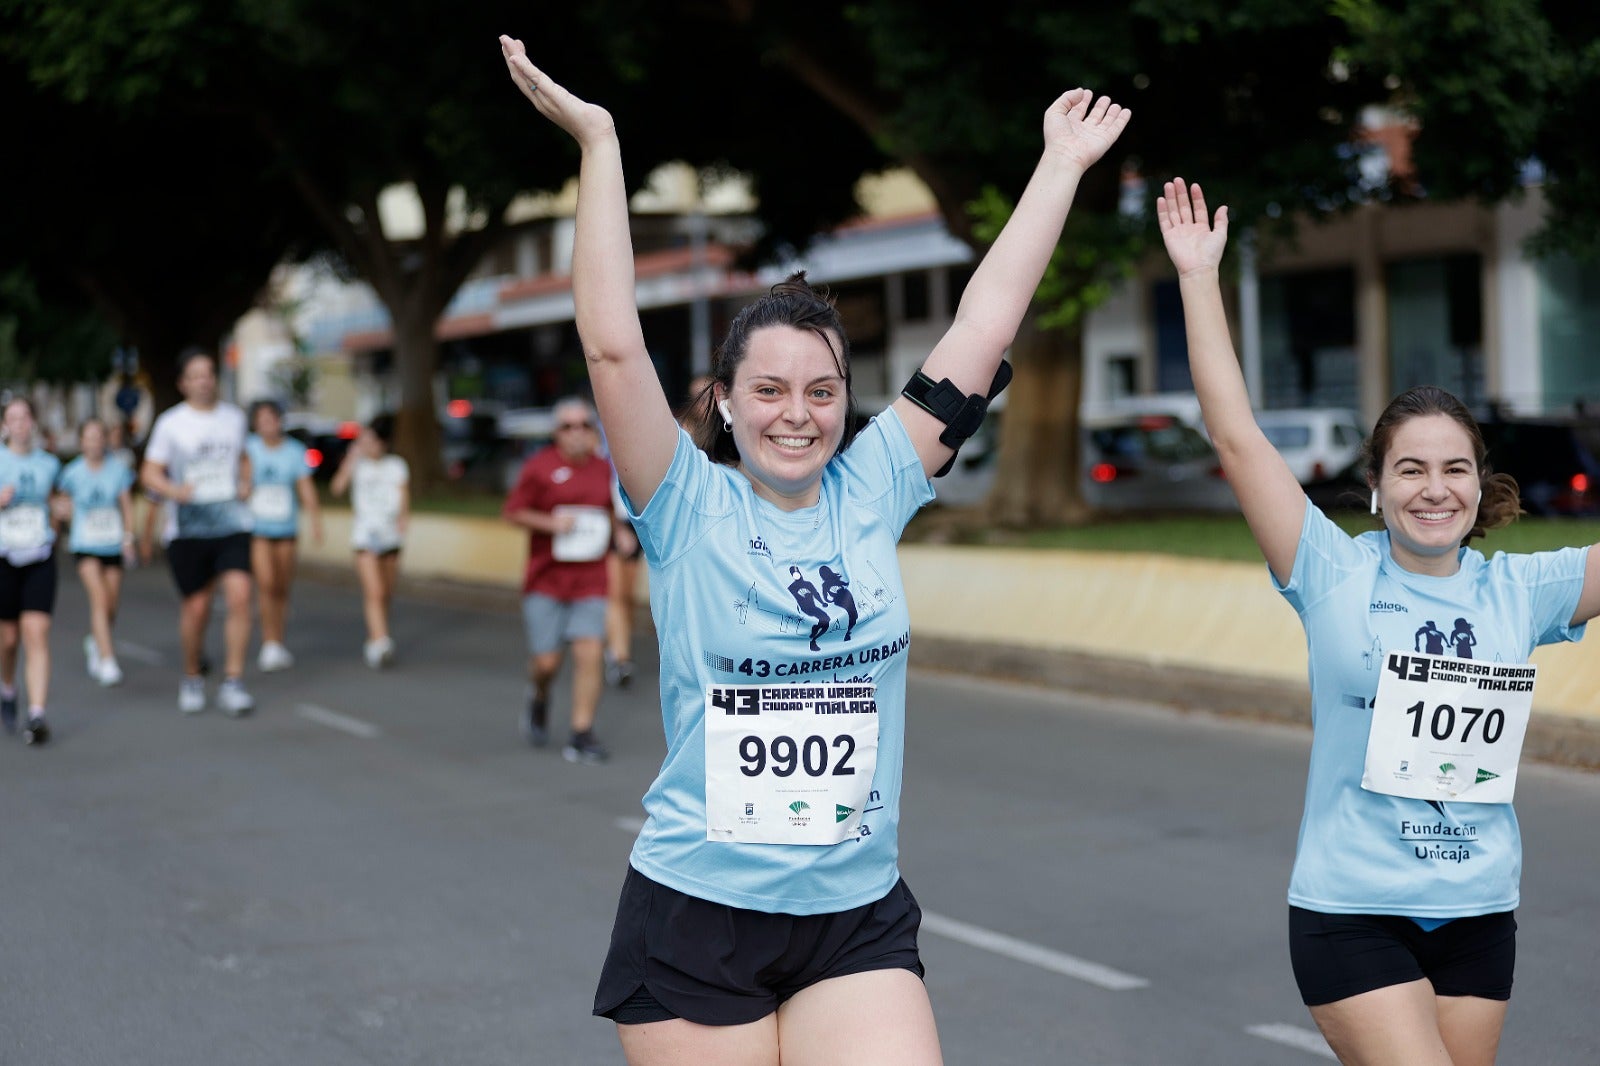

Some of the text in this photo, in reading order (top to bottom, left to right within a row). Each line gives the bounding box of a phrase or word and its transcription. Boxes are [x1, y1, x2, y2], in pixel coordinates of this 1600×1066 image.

[738, 657, 771, 678] 43
[775, 652, 855, 677] CARRERA
[1388, 654, 1431, 683] 43
[1432, 659, 1536, 679] CARRERA URBANA
[1430, 671, 1468, 684] CIUDAD
[711, 688, 760, 716] 43
[761, 687, 825, 700] CARRERA
[762, 701, 804, 711] CIUDAD
[1406, 700, 1505, 744] 1070
[738, 734, 856, 778] 9902
[1415, 844, 1471, 864] Unicaja
